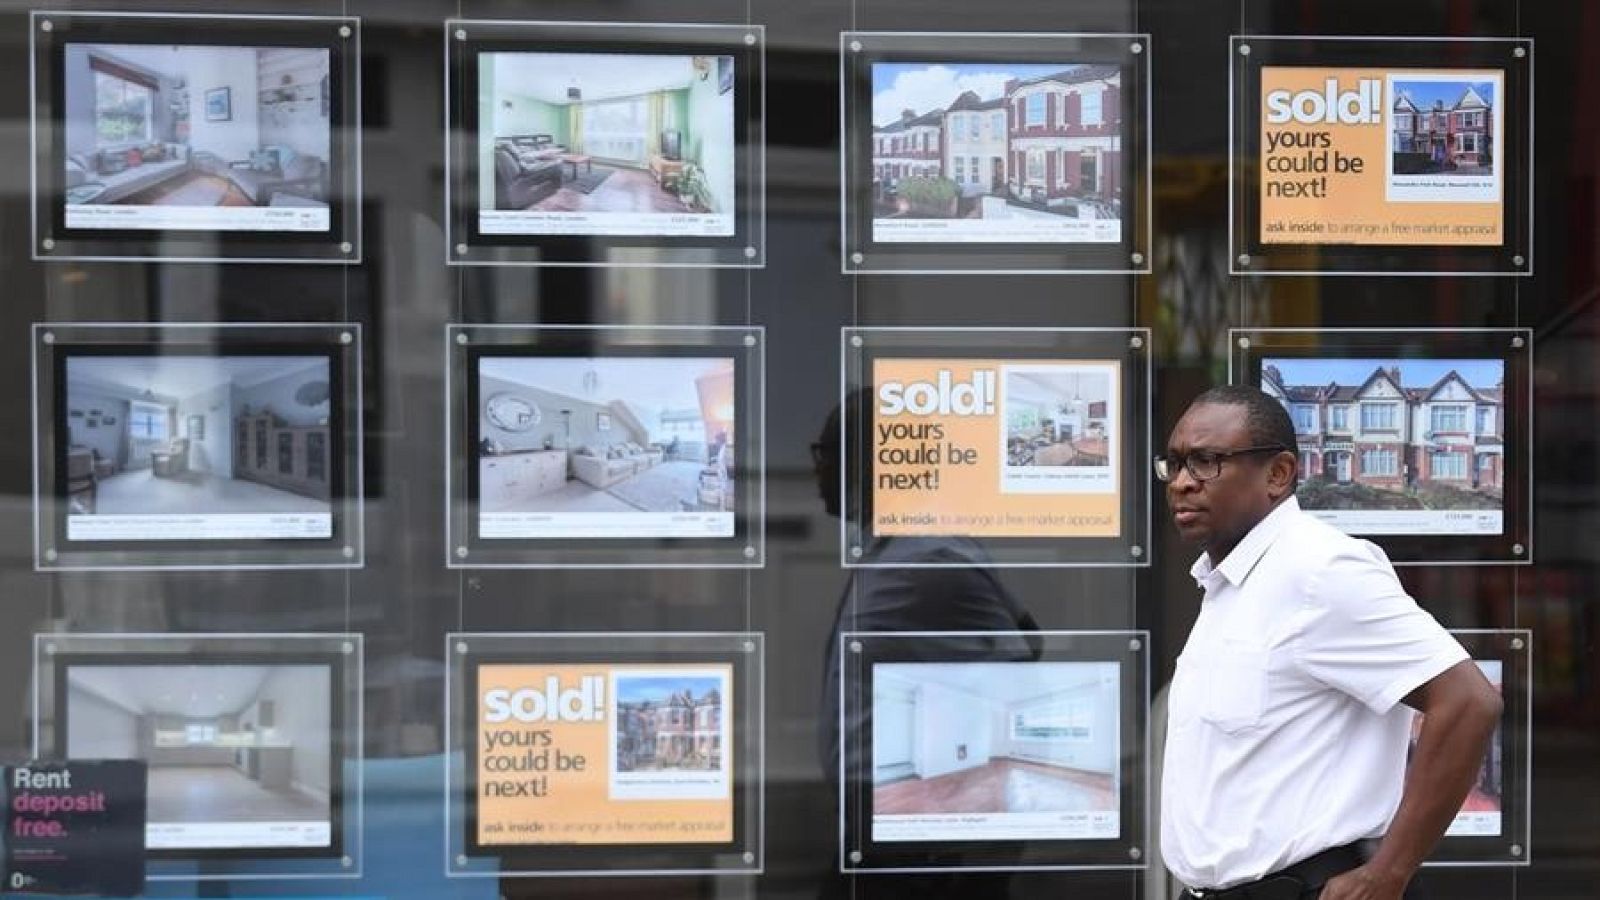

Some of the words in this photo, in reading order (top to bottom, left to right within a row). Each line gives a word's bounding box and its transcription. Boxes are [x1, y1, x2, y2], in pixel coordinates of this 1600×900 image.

[1267, 79, 1381, 124] sold!
[1266, 131, 1331, 153] yours
[1267, 151, 1328, 173] could
[1335, 151, 1363, 173] be
[1267, 177, 1326, 198] next!
[1265, 220, 1285, 232] ask
[1288, 220, 1324, 232] inside
[1340, 223, 1379, 235] arrange
[1391, 220, 1412, 232] free
[1415, 220, 1449, 232] market
[1451, 220, 1496, 235] appraisal
[879, 370, 995, 415] sold!
[878, 423, 944, 445] yours
[878, 443, 940, 465] could
[948, 443, 977, 465] be
[878, 469, 939, 490] next!
[878, 512, 898, 524] ask
[901, 512, 937, 524] inside
[1028, 512, 1064, 524] market
[1066, 512, 1112, 527] appraisal
[485, 675, 605, 722] sold!
[484, 729, 552, 751] yours
[484, 749, 548, 772] could
[556, 749, 586, 772] be
[14, 767, 72, 789] Rent
[484, 775, 547, 797] next!
[14, 791, 106, 816] deposit
[14, 817, 68, 837] free.
[484, 820, 503, 832] ask
[508, 820, 544, 832] inside
